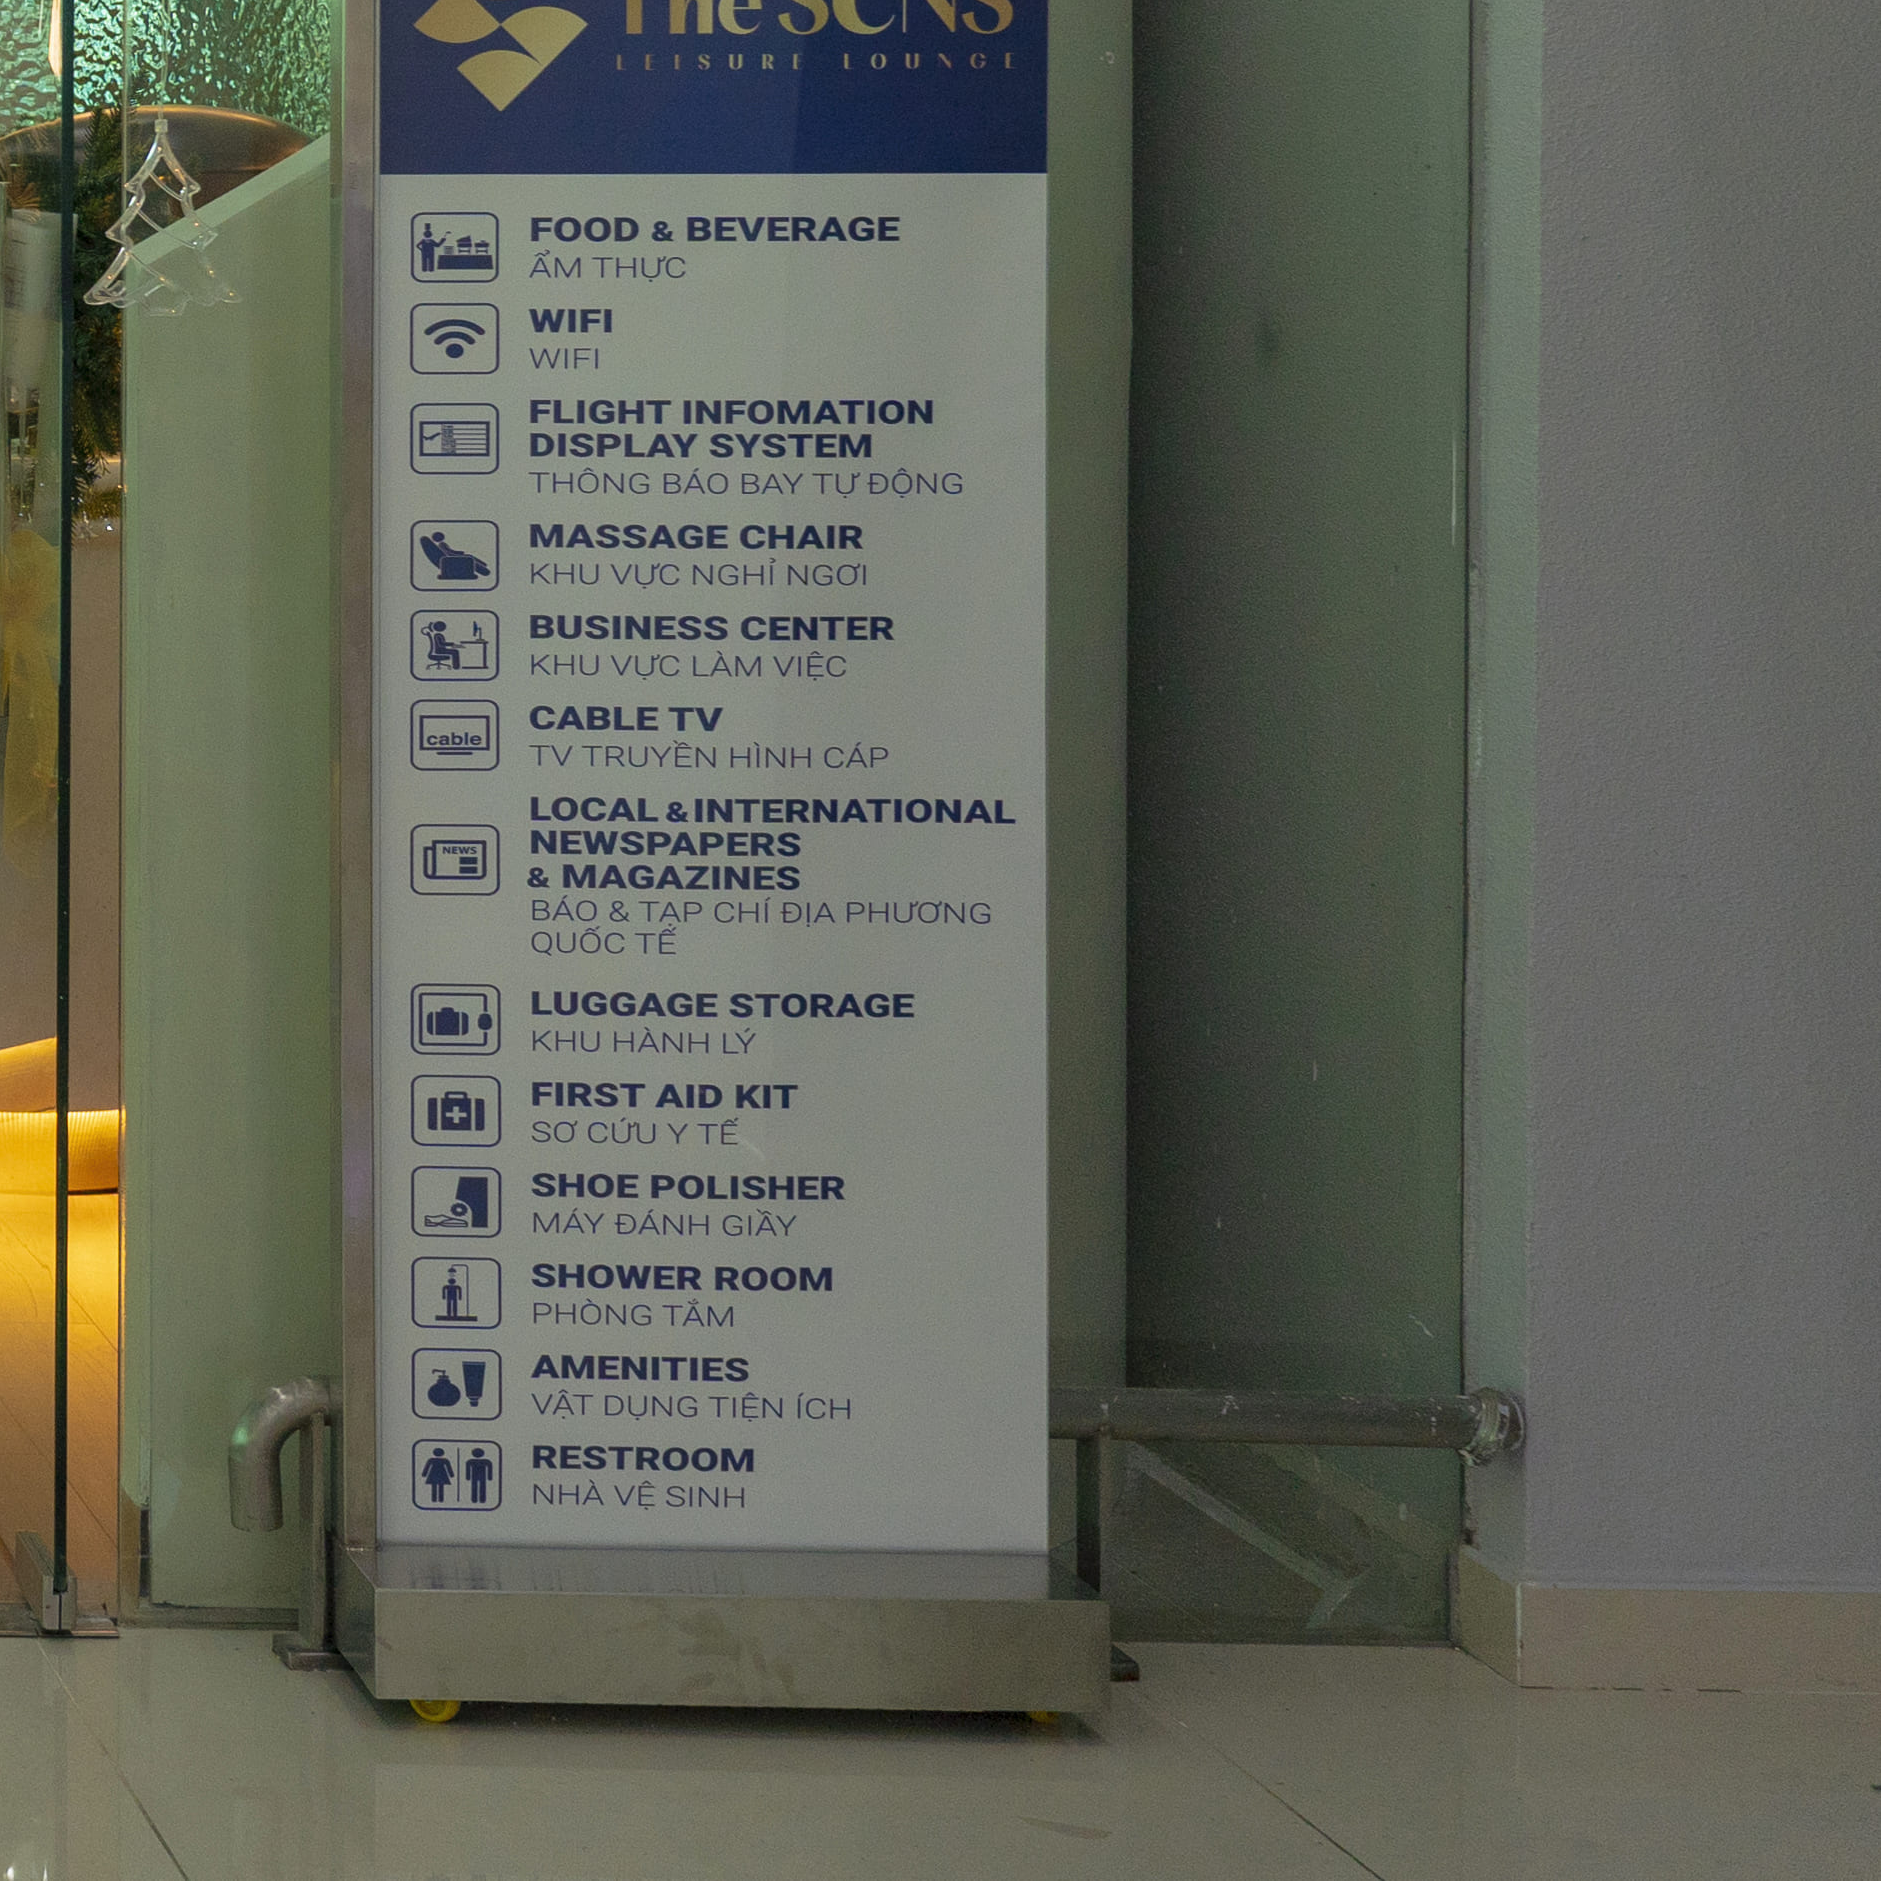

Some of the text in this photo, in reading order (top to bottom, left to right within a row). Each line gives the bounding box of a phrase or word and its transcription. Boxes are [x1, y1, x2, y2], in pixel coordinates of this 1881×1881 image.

[531, 217, 900, 242] FOOD & BEVERAGE
[529, 250, 686, 282] ẨM THỰC
[529, 309, 612, 333] WIFI
[529, 348, 599, 369] WIFI
[530, 400, 933, 424] FLIGHT INFOMATION
[530, 433, 872, 458] DISPLAY SYSTEM
[529, 467, 963, 498] THÔNG BÁO BAY TỰ ĐỘNG
[530, 524, 862, 549] MASSAGE CHAIR
[531, 558, 866, 589] KHU VỰC NGHỈ NGƠI
[530, 615, 893, 640] BUSINESS CENTER
[531, 651, 846, 681] KHU VỰC LÀM VIỆC
[530, 706, 723, 731] CABLE TV
[426, 732, 482, 747] cable
[529, 740, 889, 768] TV TRUYỀN HÌNH CÁP
[531, 797, 1016, 824] LOCAL & INTERNATIONAL
[441, 845, 478, 856] NEWS
[531, 830, 801, 857] NEWSPAPERS
[527, 864, 800, 890] & MAGAZINES
[532, 895, 991, 927] BÁO & TẠP CHÍ ĐỊA PHƯƠNG
[531, 926, 677, 956] QUỐC TẾ
[532, 991, 914, 1018] LUGGAGE STORAGE
[532, 1027, 756, 1054] KHU HÀNH LÝ
[532, 1082, 798, 1109] FIRST AID KIT
[532, 1117, 738, 1145] SƠ CỨU Y TẾ
[532, 1173, 844, 1200] SHOE POLISHER
[533, 1208, 604, 1234] MÁY
[615, 1209, 709, 1236] ĐÁNH
[532, 1264, 832, 1291] SHOWER ROOM
[533, 1298, 734, 1327] PHÒNG TẮM
[532, 1355, 748, 1382] AMENITIES
[531, 1389, 851, 1422] VẬT DỤNG TIỆN ÍCH
[533, 1445, 754, 1472] RESTROOM
[533, 1479, 745, 1510] NHÀ VỆ SINH
